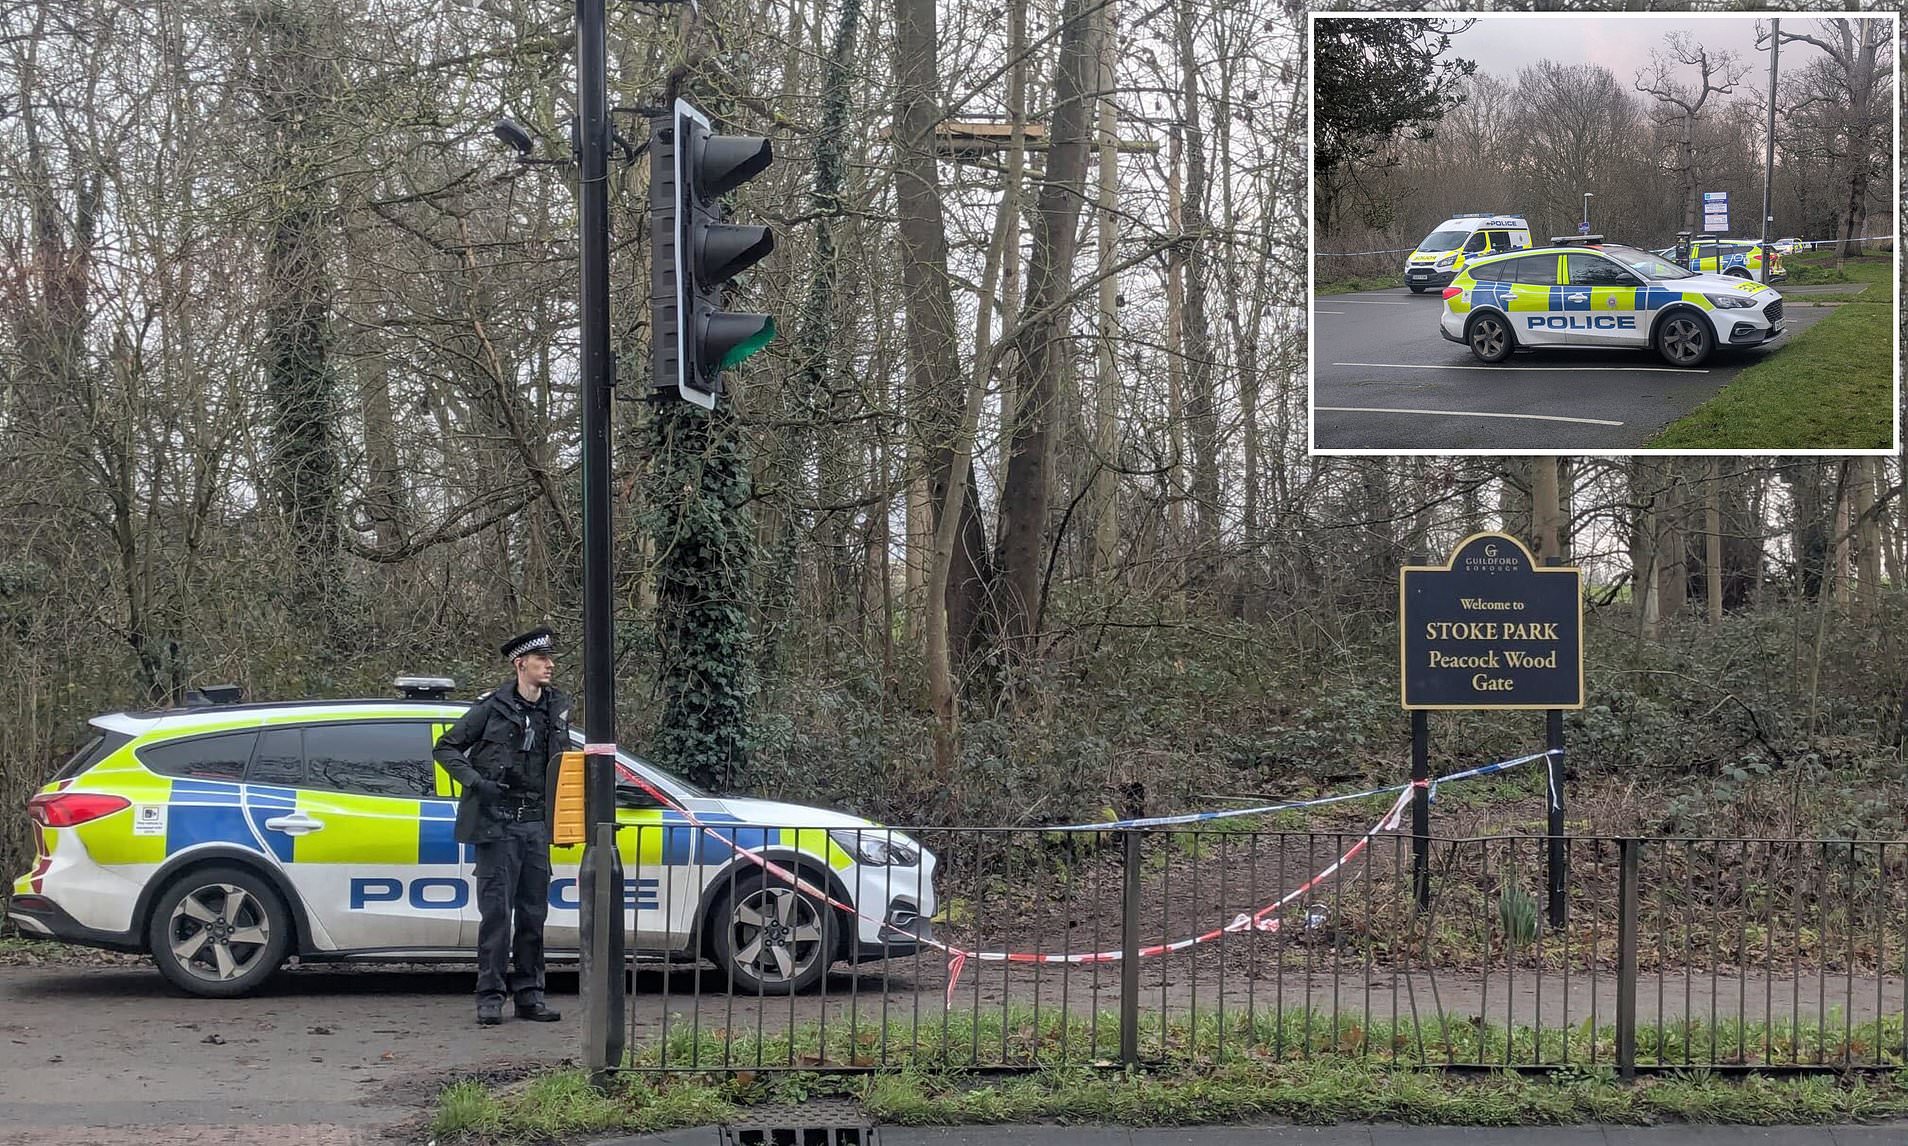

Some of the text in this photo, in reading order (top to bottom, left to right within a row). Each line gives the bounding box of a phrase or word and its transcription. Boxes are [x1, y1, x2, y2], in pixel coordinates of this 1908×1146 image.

[1527, 315, 1637, 330] POLICE
[1465, 557, 1519, 565] GUILDFORD
[1460, 598, 1525, 611] Welcome to
[1425, 622, 1560, 640] STOKE PARK
[1429, 650, 1557, 668] Peacock Wood
[1472, 673, 1514, 691] Gate
[350, 877, 660, 910] POCE
